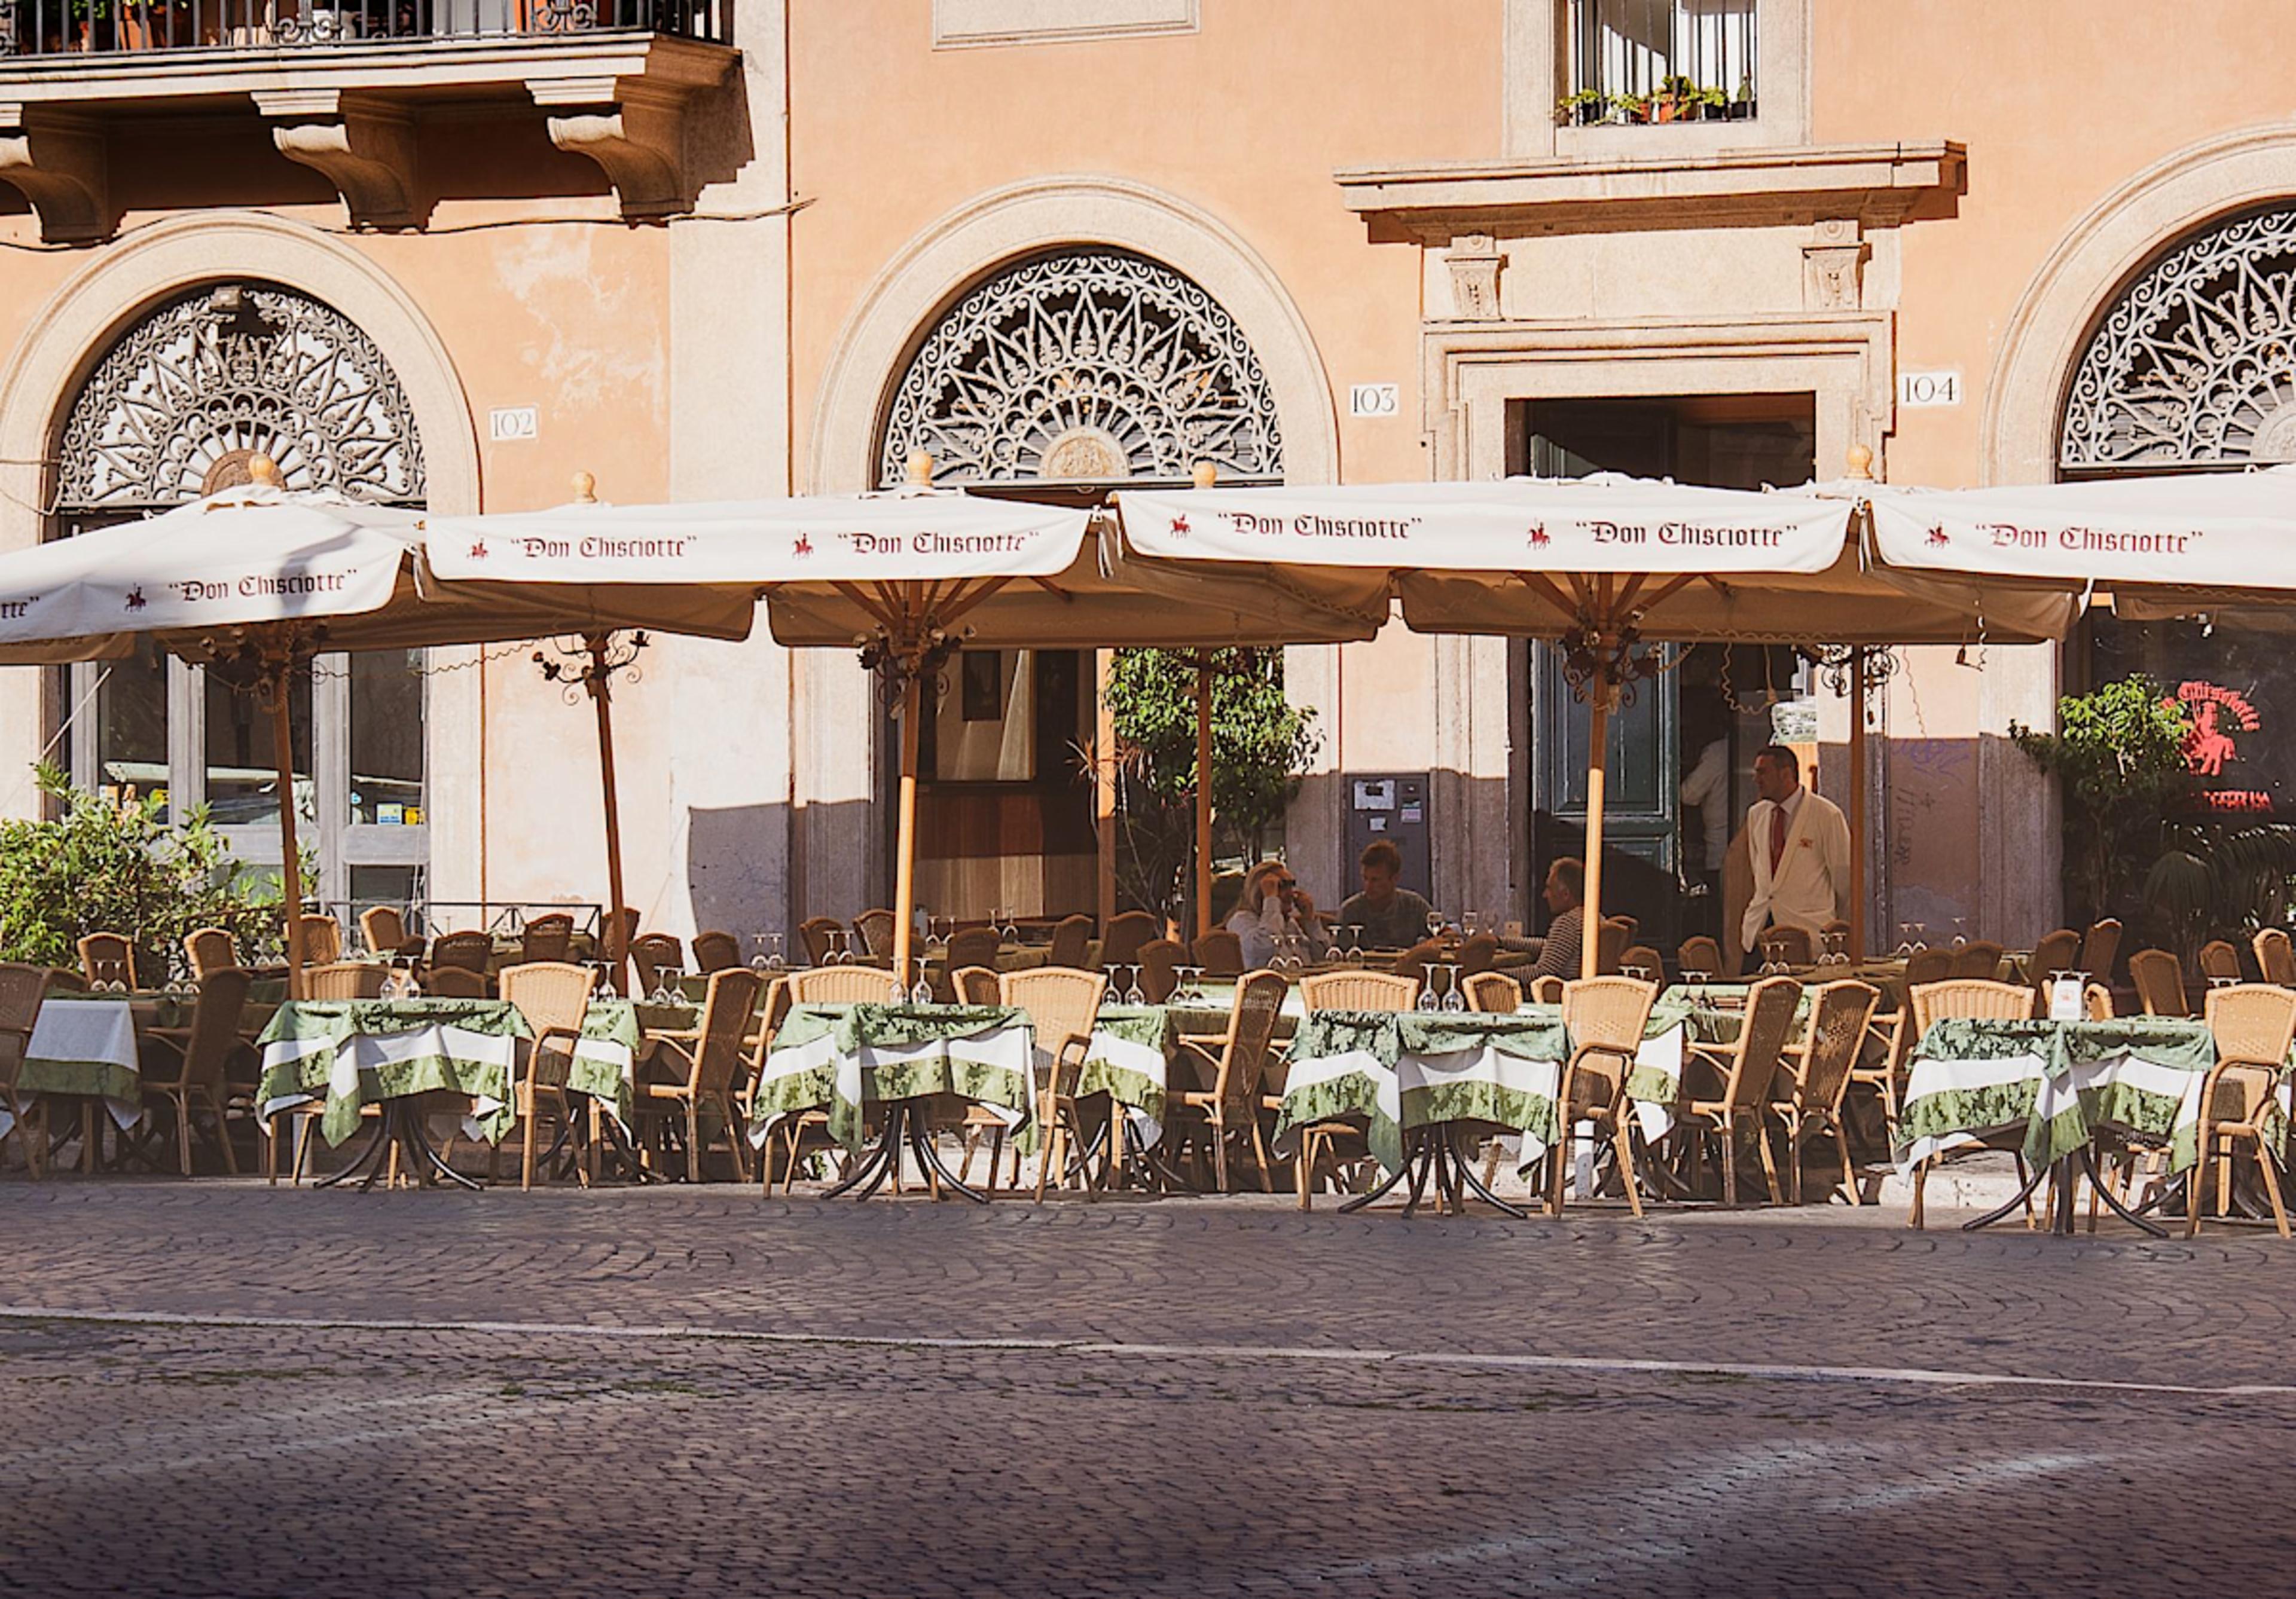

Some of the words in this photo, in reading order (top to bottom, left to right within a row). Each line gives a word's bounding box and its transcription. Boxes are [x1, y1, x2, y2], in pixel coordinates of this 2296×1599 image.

[1353, 387, 1396, 413] 103
[1906, 376, 1957, 402] 104
[493, 412, 533, 437] 102
